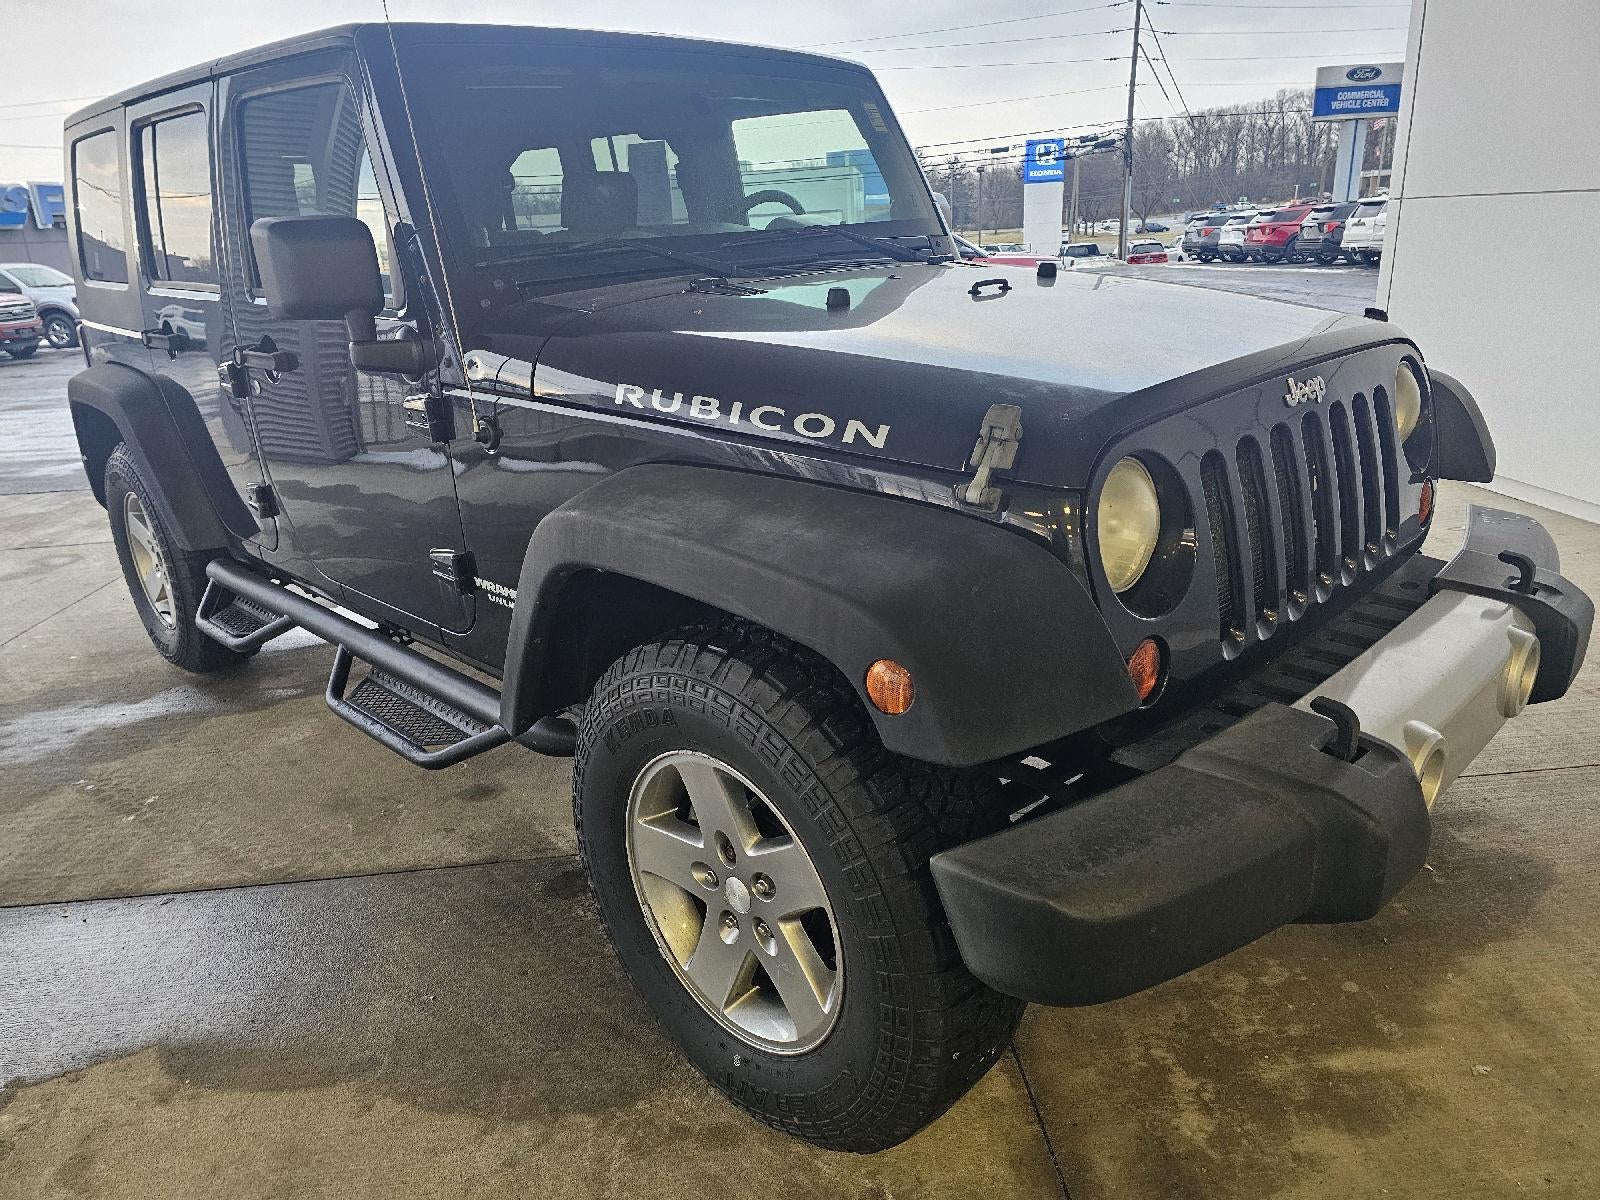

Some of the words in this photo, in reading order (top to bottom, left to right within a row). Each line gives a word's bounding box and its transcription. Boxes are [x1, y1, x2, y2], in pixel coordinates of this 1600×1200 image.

[1331, 100, 1361, 110] VEHICLE
[1362, 98, 1389, 108] CENTER
[1337, 90, 1385, 100] COMMERCIAL
[1285, 375, 1327, 407] Jeep
[614, 383, 891, 449] RUBICON
[602, 707, 679, 752] KENDA
